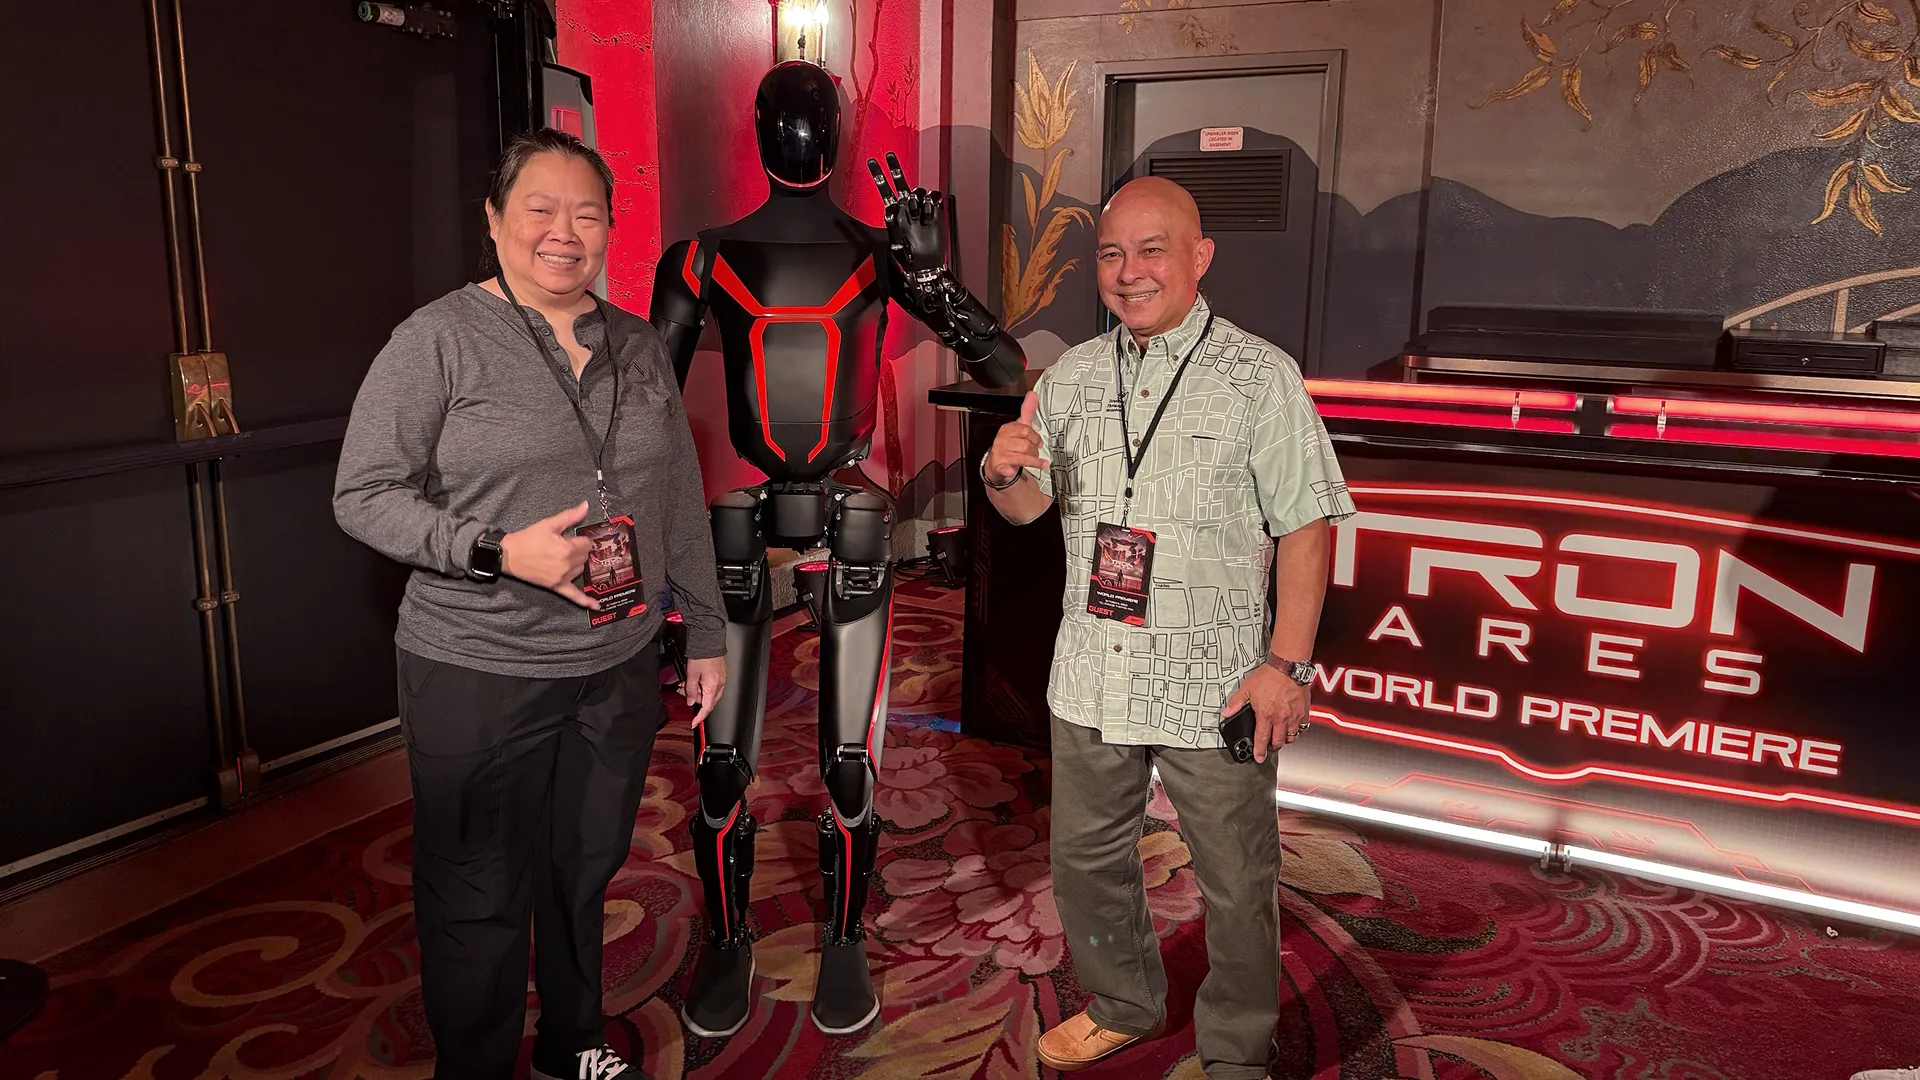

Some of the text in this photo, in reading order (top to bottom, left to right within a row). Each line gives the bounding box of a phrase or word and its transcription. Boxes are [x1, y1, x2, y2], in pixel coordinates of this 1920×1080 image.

[1333, 511, 1876, 653] TRON
[591, 612, 617, 626] GUEST
[1089, 605, 1113, 616] GUEST
[1521, 696, 1842, 775] PREMIERE
